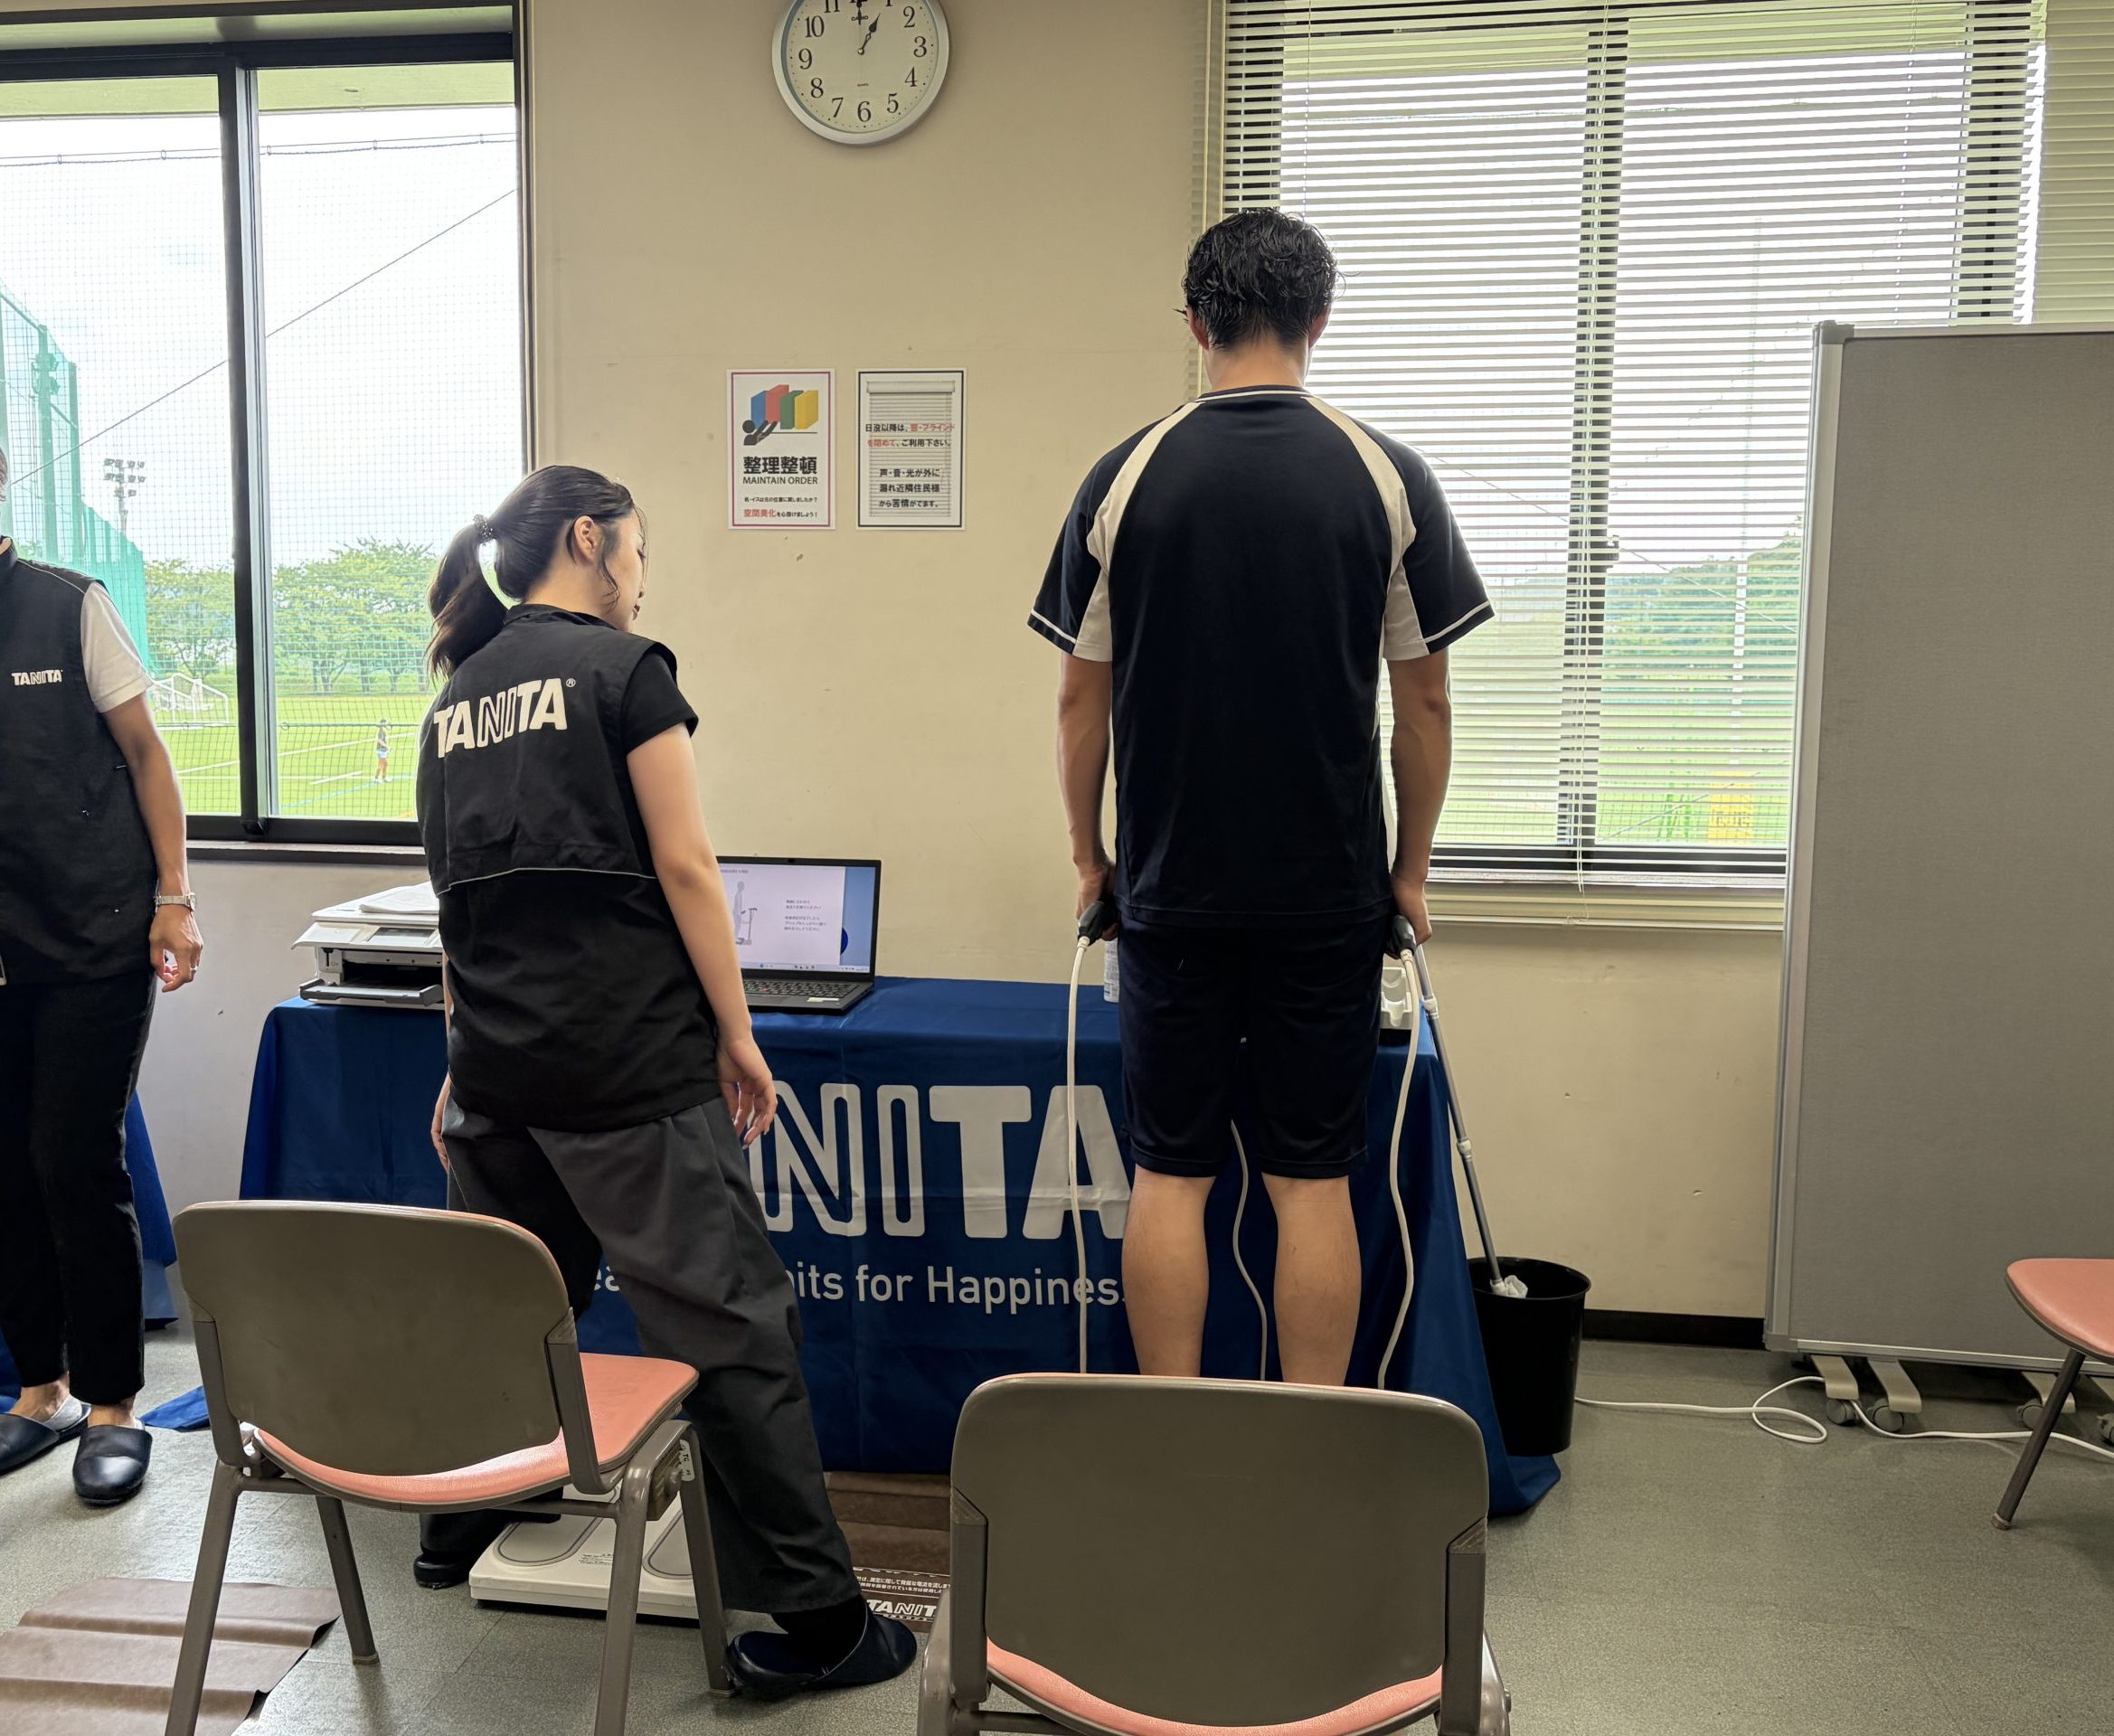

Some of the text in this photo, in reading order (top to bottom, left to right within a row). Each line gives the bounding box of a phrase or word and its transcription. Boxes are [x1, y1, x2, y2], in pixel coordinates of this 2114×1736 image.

[805, 15, 825, 38] 10
[903, 6, 916, 28] 2
[913, 36, 927, 57] 3
[798, 48, 813, 70] 9
[904, 67, 918, 87] 4
[810, 78, 824, 99] 8
[831, 97, 844, 118] 7
[857, 101, 872, 122] 6
[886, 92, 899, 113] 5
[743, 456, 817, 475] 整理整頓
[742, 476, 818, 485] MAINTAIN ORDER
[12, 669, 62, 685] TANITA
[855, 1264, 913, 1303] for
[928, 1267, 1125, 1314] Happines
